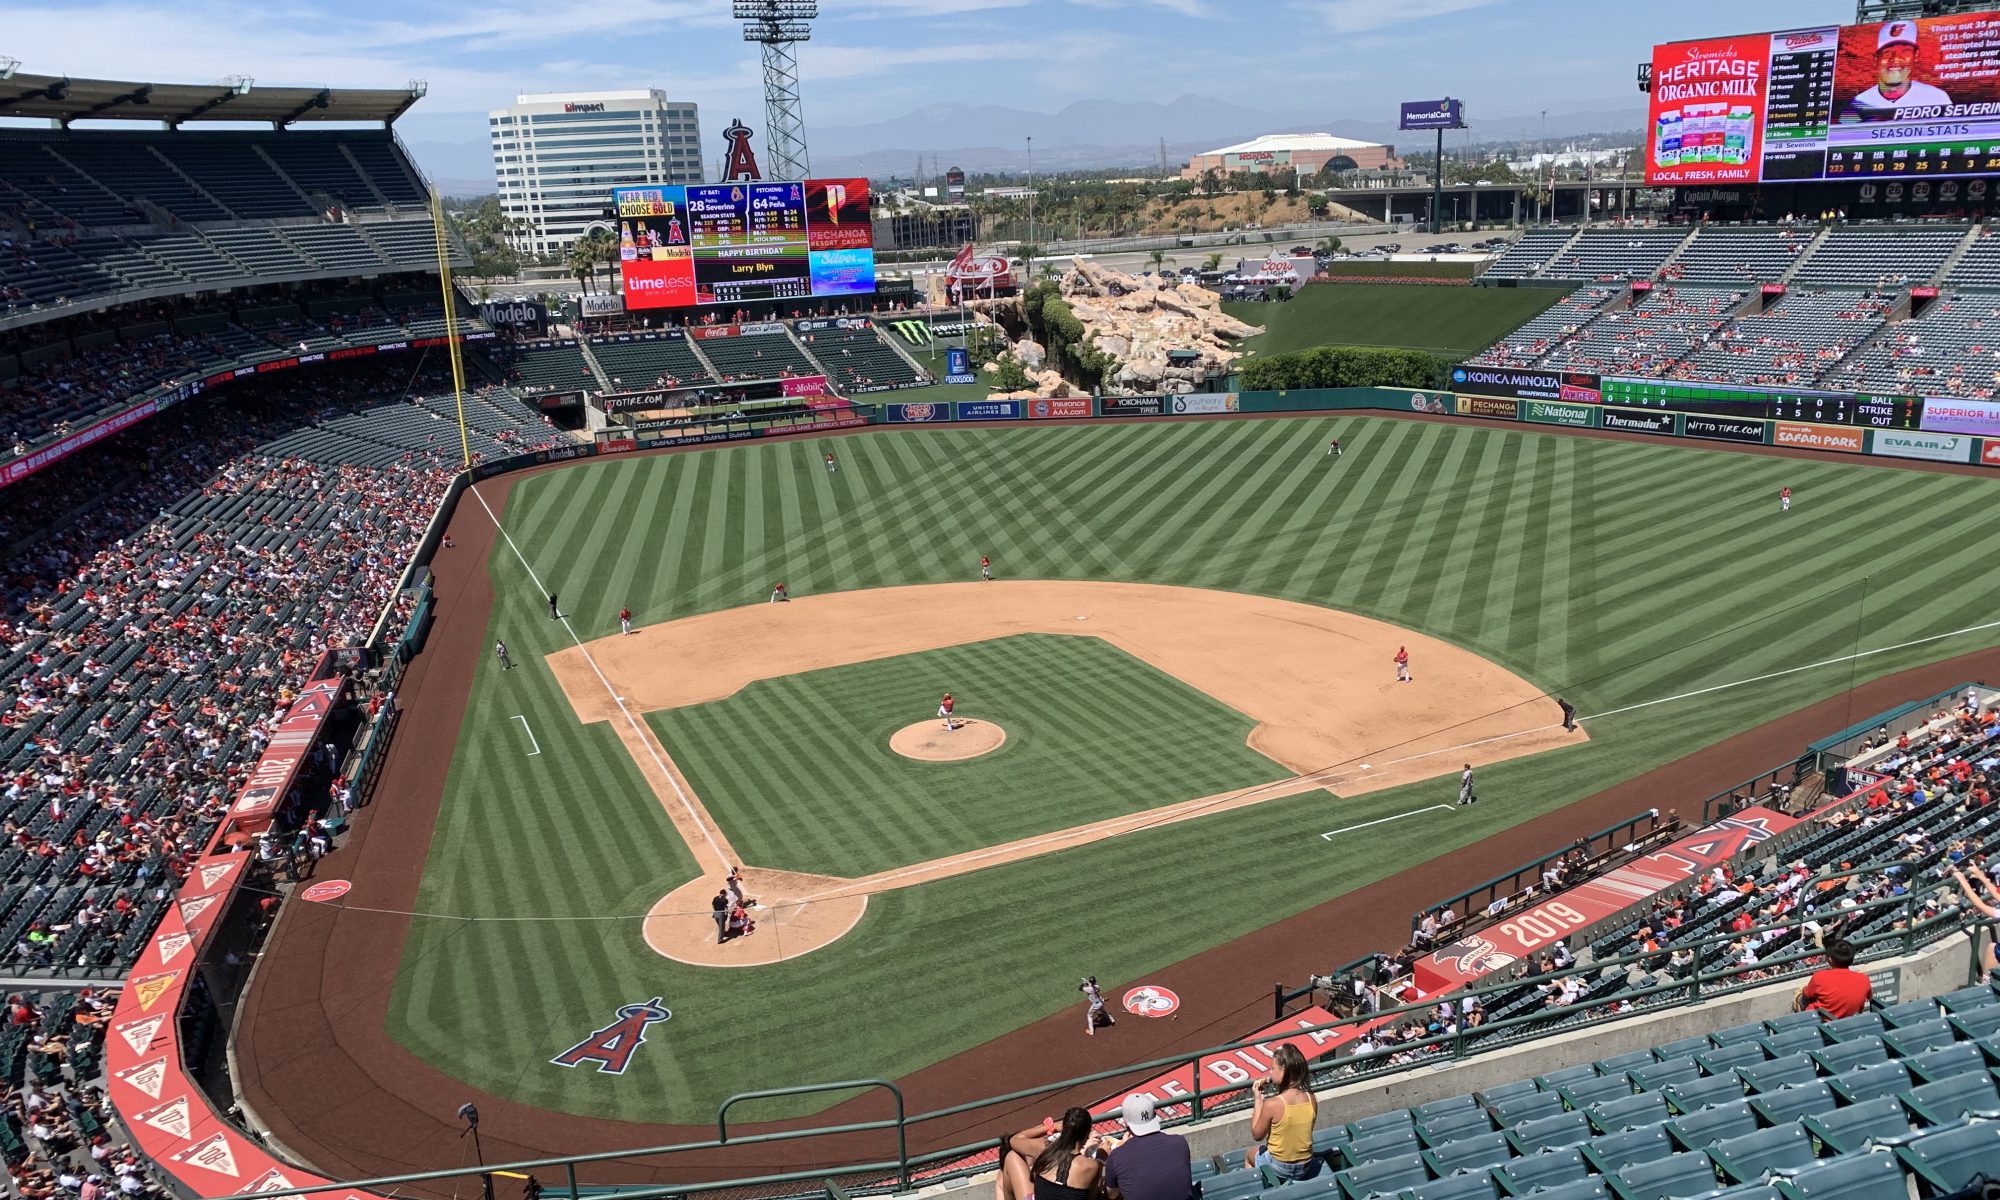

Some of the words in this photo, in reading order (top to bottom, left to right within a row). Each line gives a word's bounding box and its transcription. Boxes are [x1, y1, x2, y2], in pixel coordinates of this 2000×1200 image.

[1941, 40, 1984, 51] attempted
[1945, 51, 1978, 60] stealers
[1980, 50, 1999, 58] over
[1935, 61, 1981, 71] seven-year
[1659, 60, 1758, 86] HERITAGE
[1940, 70, 1970, 80] League
[1972, 69, 1999, 77] career
[1658, 81, 1723, 103] ORGANIC
[1722, 78, 1758, 96] MILK
[1406, 111, 1452, 120] MemorialCare
[1894, 105, 1942, 120] PEDRO
[1871, 126, 1923, 139] SEASON
[1927, 124, 1969, 136] STATS
[1239, 152, 1273, 160] HONDA
[1872, 163, 1884, 171] 10
[1893, 162, 1905, 170] 29
[1916, 161, 1928, 170] 25
[1941, 161, 1948, 169] 2
[1967, 160, 1974, 168] 3
[1653, 172, 1682, 181] LOCAL,
[1685, 170, 1715, 179] FRESH,
[1717, 169, 1750, 178] FAMILY
[618, 191, 641, 203] WEAR
[642, 190, 658, 202] RED
[1684, 190, 1711, 203] Captain
[1711, 189, 1740, 203] Morgan
[620, 204, 651, 215] CHOOSE
[652, 202, 673, 214] GOLD
[690, 201, 705, 211] 28
[705, 203, 735, 211] Severino
[753, 199, 768, 209] 64
[768, 200, 785, 208] Peña
[810, 229, 867, 240] PECHANGA
[666, 247, 692, 258] Modelo
[718, 250, 743, 258] HAPPY
[745, 247, 784, 256] BIRTHDAY
[732, 264, 754, 274] Larry
[756, 262, 774, 272] Blyn
[1261, 259, 1293, 271] Coors
[629, 274, 693, 291] timeless
[586, 299, 618, 311] Modelo
[482, 303, 537, 324] Modelo
[1468, 371, 1510, 385] KONICA
[1511, 375, 1560, 389] MINOLTA
[1052, 400, 1086, 408] Insurance
[1117, 398, 1159, 406] YOKOHAMA
[1473, 400, 1516, 411] PECHANGA
[1871, 396, 1894, 405] BALL
[1052, 408, 1086, 416] AAA.com
[1140, 406, 1159, 414] TIRES
[1544, 404, 1588, 419] National
[1776, 407, 1782, 416] 2
[1795, 409, 1801, 417] 5
[1815, 411, 1822, 419] 0
[1837, 412, 1844, 421] 3
[1858, 405, 1893, 415] STRIKE
[1905, 409, 1912, 417] 2
[1927, 407, 1984, 418] SUPERIOR
[1605, 414, 1661, 430] Thermador
[1871, 416, 1892, 426] OUT
[769, 425, 796, 434] AMERICA'S
[812, 422, 839, 430] AMERICA'S
[1688, 420, 1716, 431] NITTO
[1719, 422, 1763, 436] TIRE.COM
[651, 439, 675, 447] StubHub
[677, 436, 701, 445] StubHub
[703, 433, 726, 442] StubHub
[728, 430, 752, 439] StubHub
[1778, 432, 1822, 444] SAFARI
[1823, 437, 1858, 448] PARK
[1884, 438, 1911, 447] EVA
[1911, 440, 1939, 449] AIR
[549, 448, 575, 460] Modelo
[250, 757, 296, 786] 2019
[1500, 902, 1587, 949] 2019
[1463, 943, 1491, 967] AMERICAN
[158, 1108, 184, 1126] '07
[198, 1145, 227, 1165] '08
